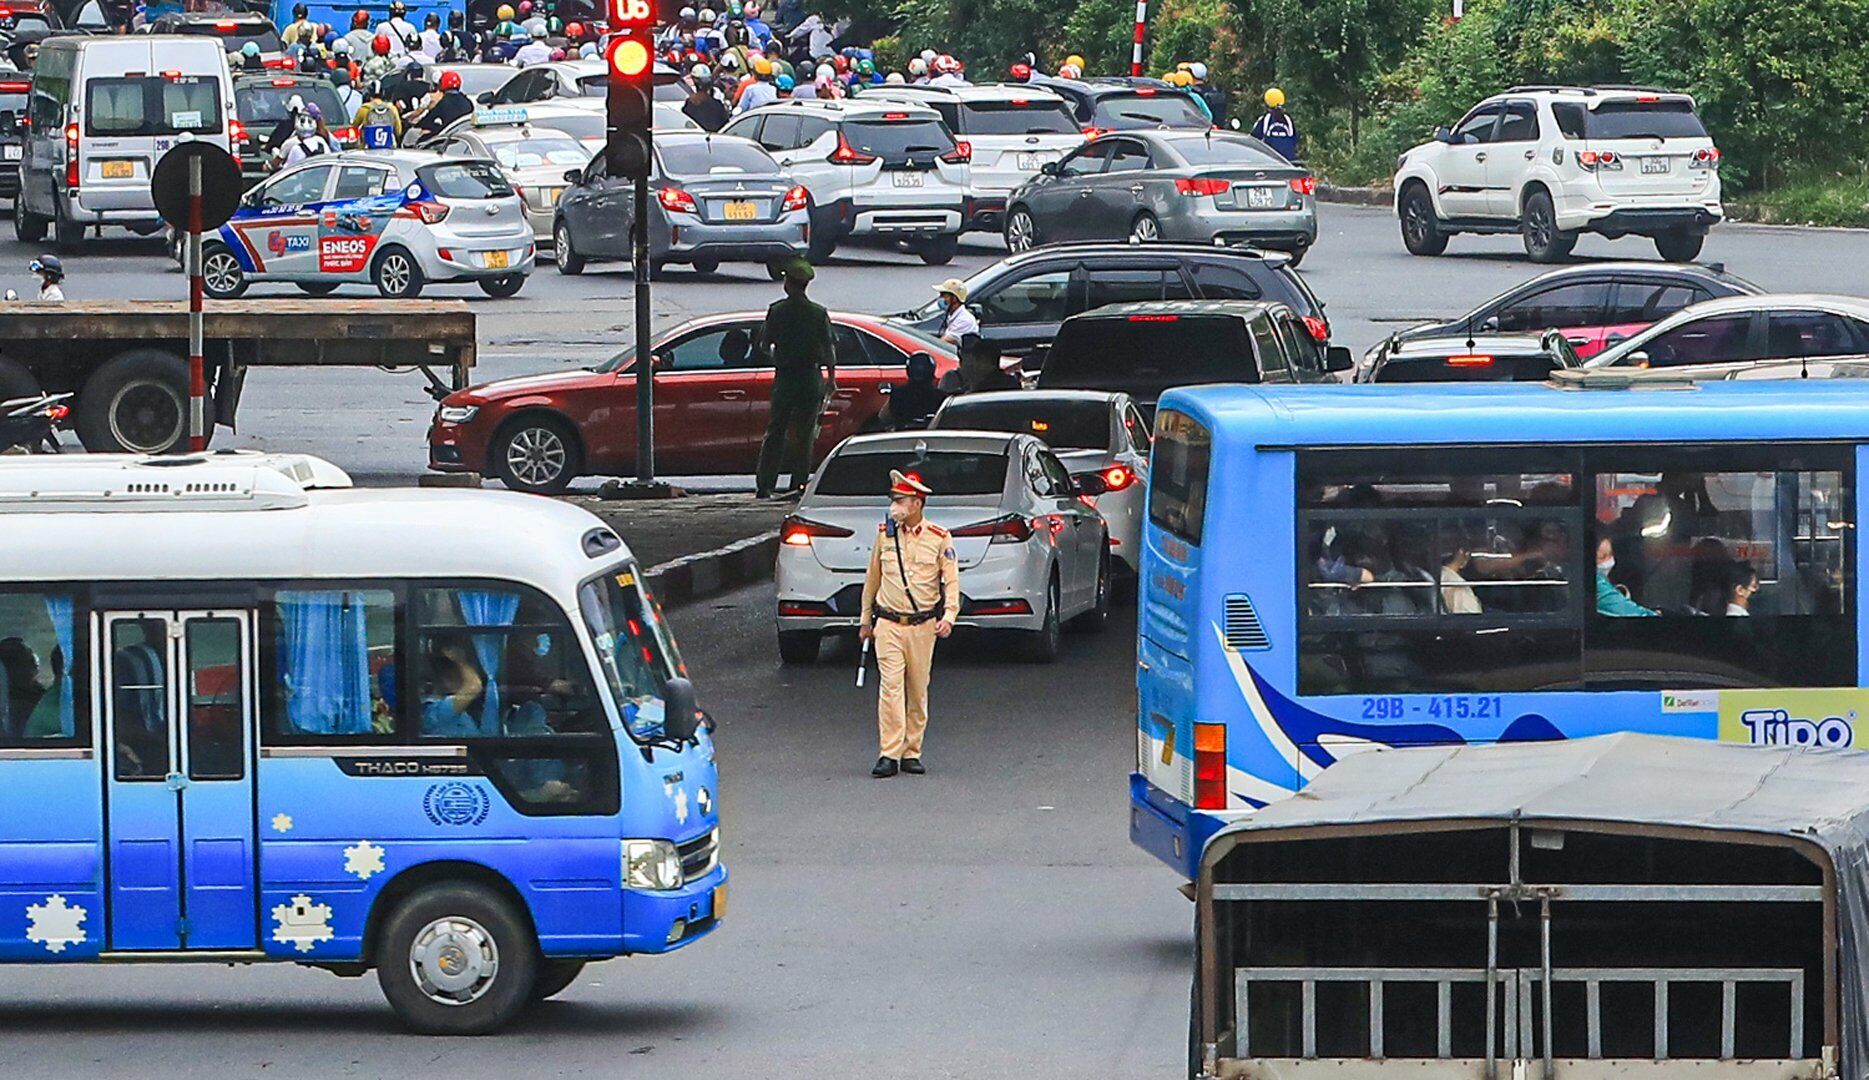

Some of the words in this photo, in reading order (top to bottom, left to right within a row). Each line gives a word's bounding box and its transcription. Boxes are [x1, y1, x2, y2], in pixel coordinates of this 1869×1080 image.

[286, 236, 309, 248] TAXI
[322, 240, 366, 254] ENEOS
[1362, 697, 1405, 719] 29B
[1428, 696, 1501, 719] 415.21
[355, 762, 418, 773] THACO
